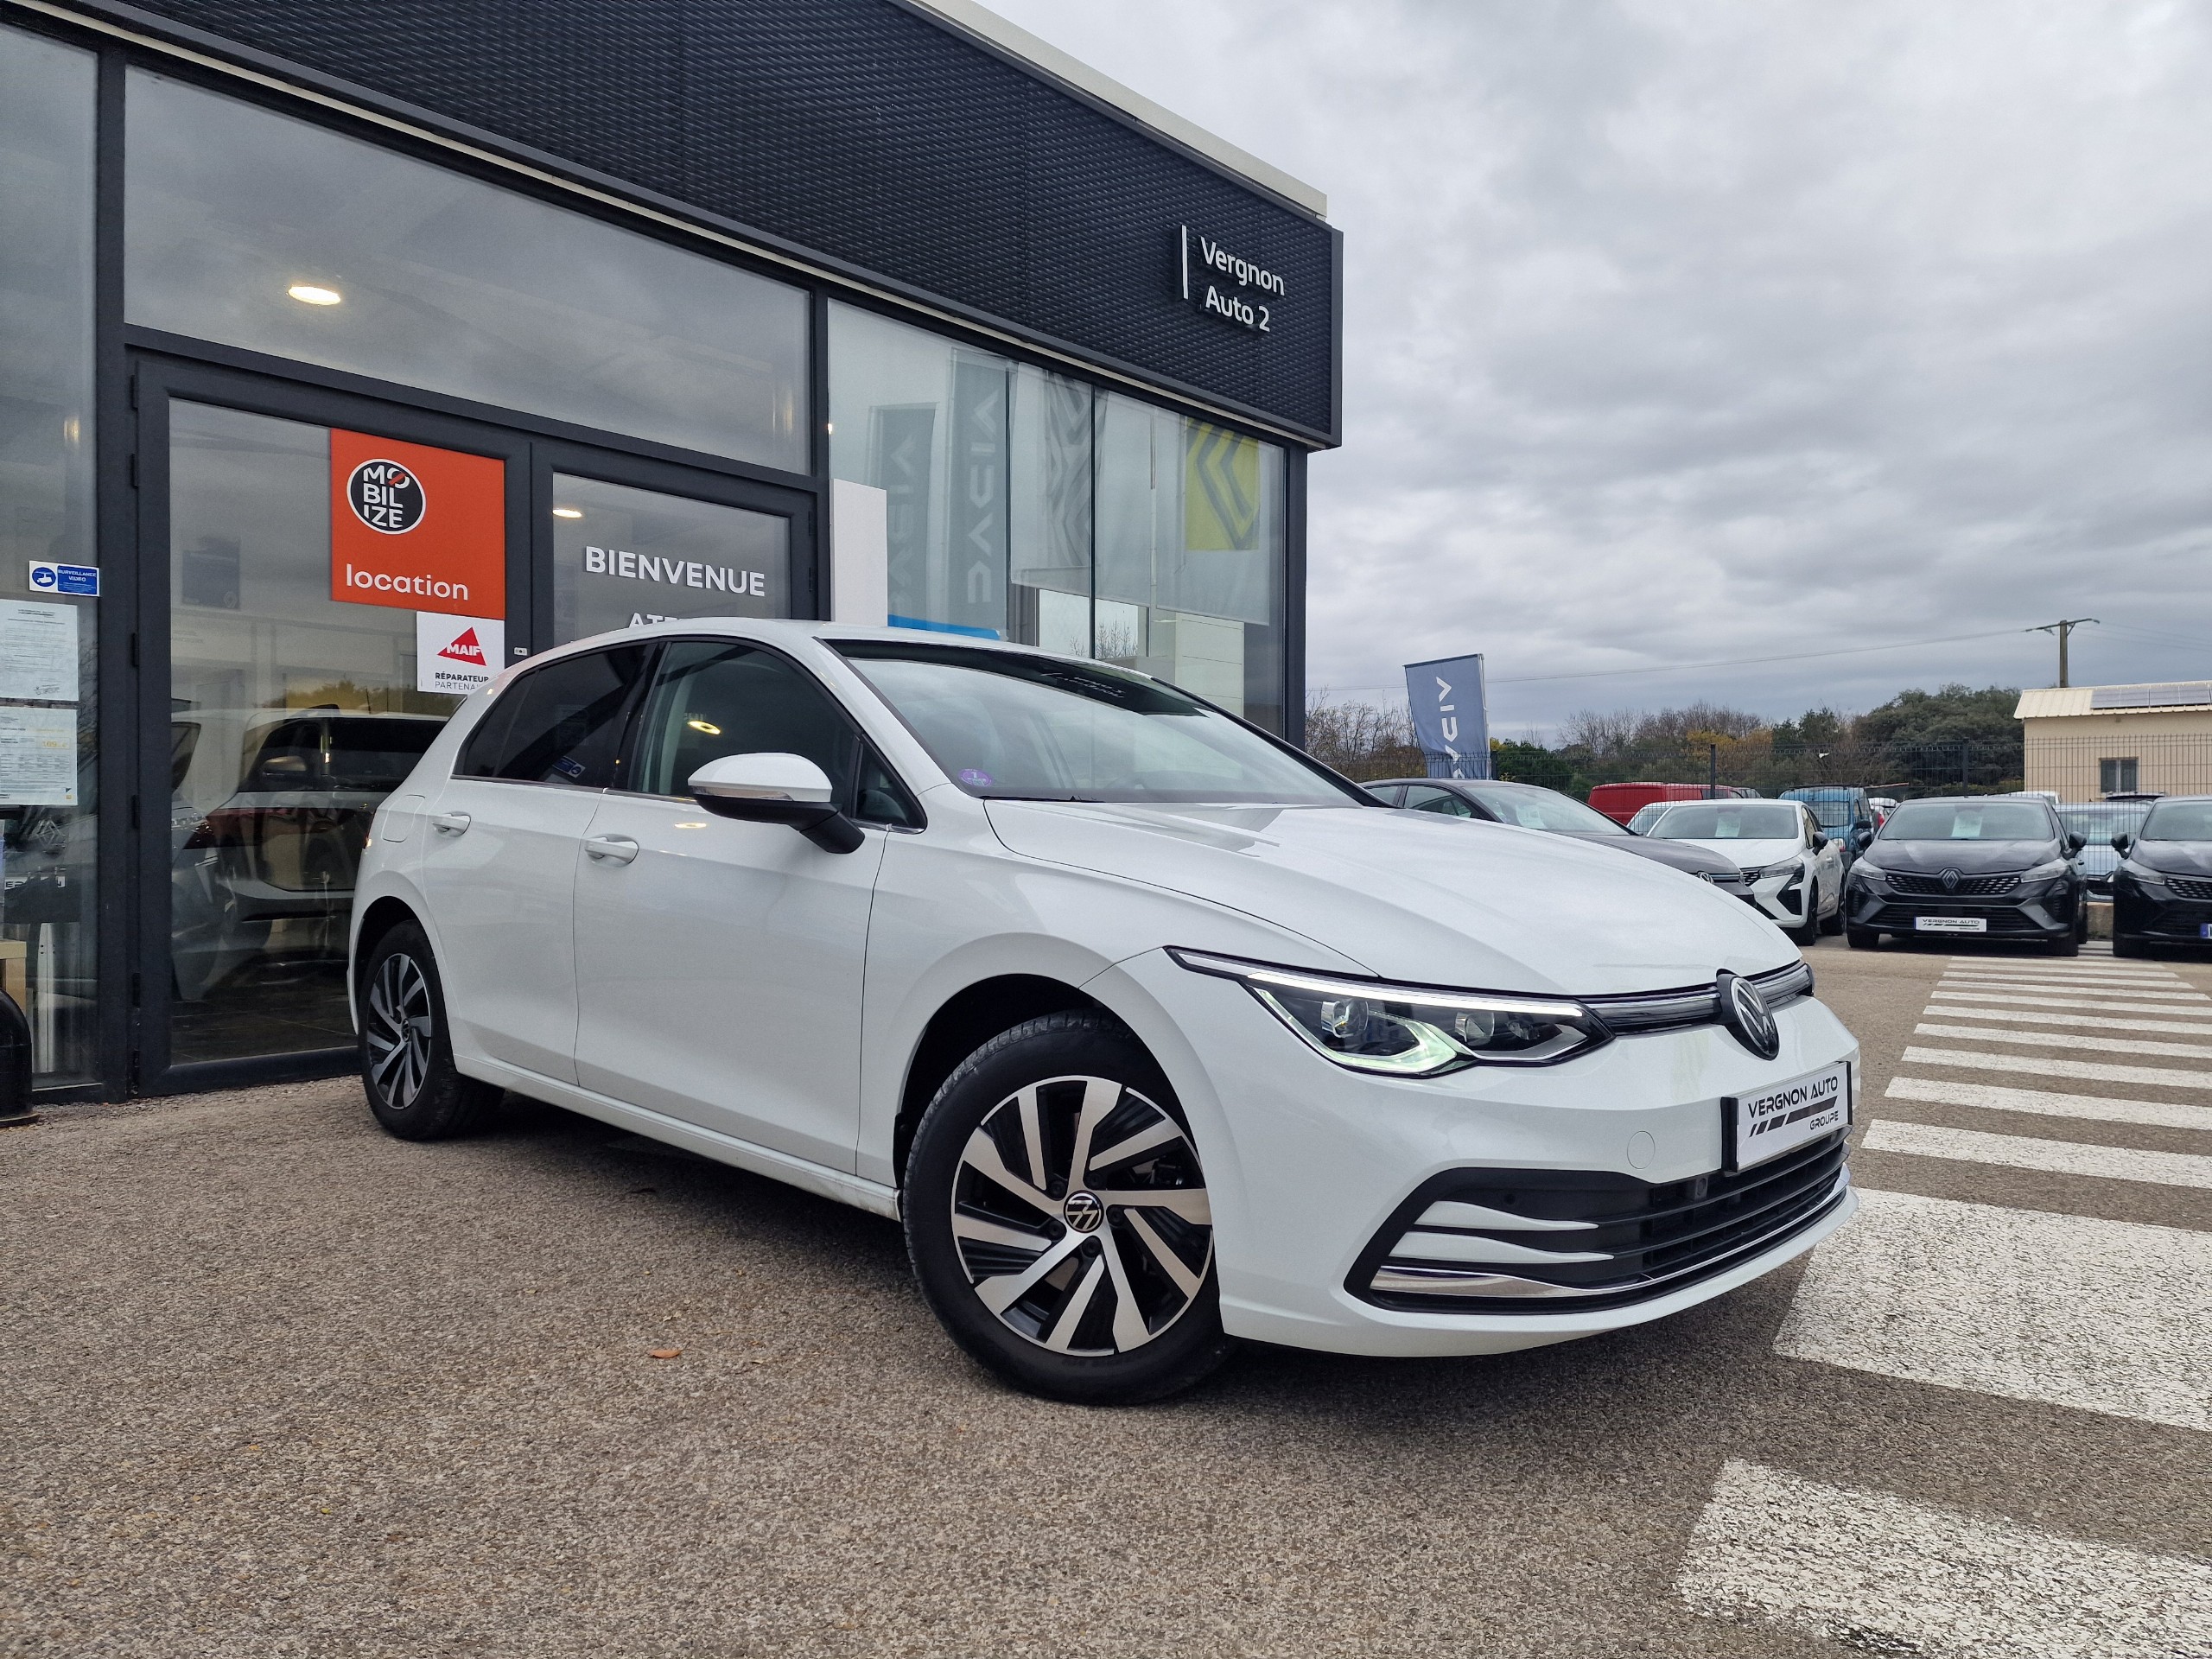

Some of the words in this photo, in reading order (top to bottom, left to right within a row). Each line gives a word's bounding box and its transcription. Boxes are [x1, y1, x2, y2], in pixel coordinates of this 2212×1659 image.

[1200, 236, 1285, 296] Vergnon
[1205, 285, 1254, 325] Auto
[1258, 305, 1270, 333] 2
[363, 483, 404, 508] BIL
[363, 505, 404, 528] IZE
[346, 563, 468, 601] location
[586, 546, 765, 597] BIENVENUE
[446, 644, 481, 656] MAIF
[1748, 1086, 1808, 1119] VERGNON
[1810, 1076, 1839, 1099] AUTO
[1809, 1110, 1839, 1130] GROUPE
